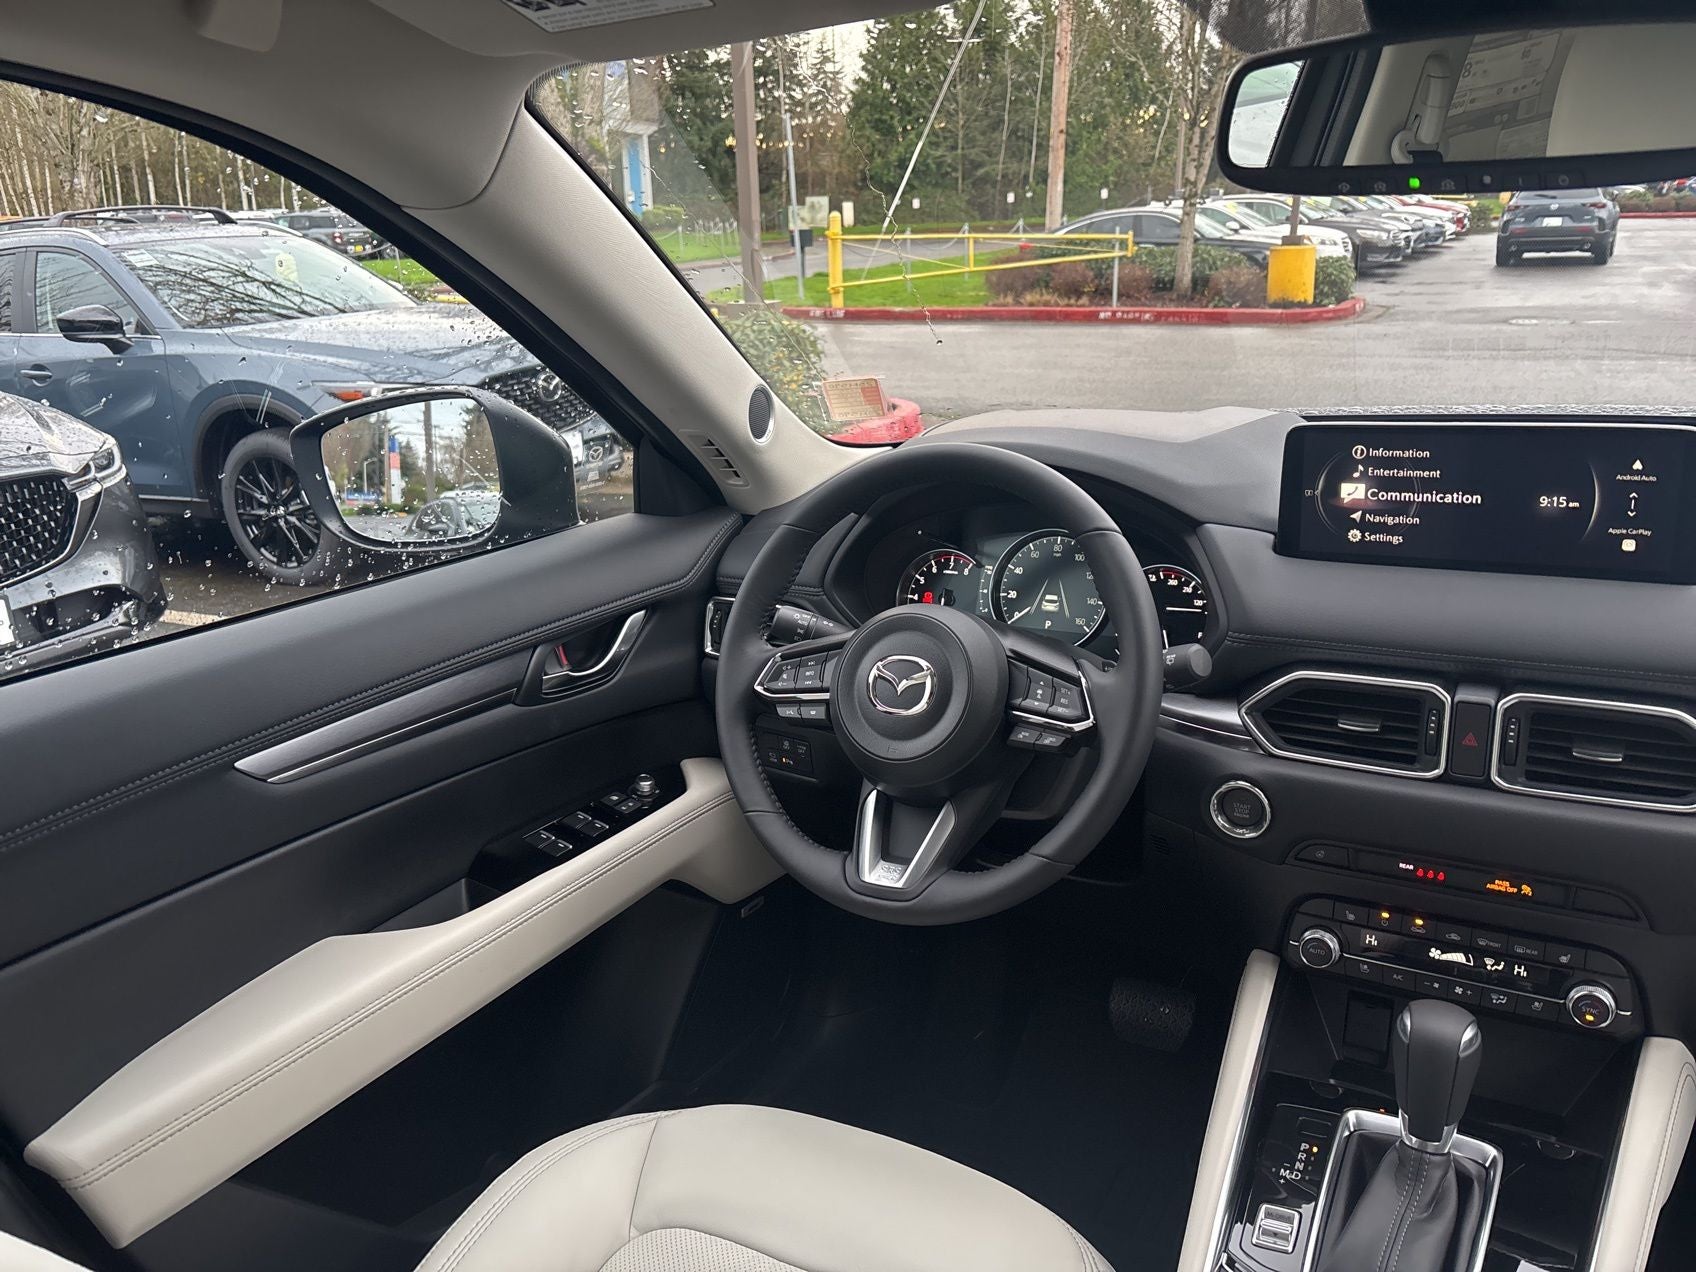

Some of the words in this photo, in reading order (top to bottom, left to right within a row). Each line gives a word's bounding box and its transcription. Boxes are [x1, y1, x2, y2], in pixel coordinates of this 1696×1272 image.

[1369, 447, 1430, 458] Information
[1368, 467, 1441, 478] Entertainment
[1367, 488, 1482, 504] Communication
[1539, 496, 1567, 508] 9:15
[1365, 513, 1420, 525] Navigation
[1608, 527, 1627, 535] Apple
[1628, 528, 1652, 537] CarPlay
[1364, 532, 1403, 545] Settings
[1053, 544, 1063, 552] 80
[1030, 551, 1039, 559] 60
[1074, 553, 1085, 561] 100
[931, 565, 937, 574] 6
[949, 562, 955, 570] 7
[1013, 566, 1023, 575] 40
[963, 568, 969, 576] 8
[919, 576, 925, 584] 5
[1007, 590, 1017, 599] 20
[1086, 597, 1098, 605] 140
[1044, 620, 1052, 629] P
[1075, 618, 1086, 626] 160
[1398, 862, 1414, 871] REAR
[1485, 882, 1506, 892] AIRBAG
[1494, 879, 1510, 887] PASS
[1308, 947, 1326, 956] AUTO
[1581, 1005, 1600, 1015] SYNC
[1299, 1142, 1310, 1151] P
[1297, 1152, 1307, 1161] R
[1294, 1160, 1305, 1171] N
[1279, 1168, 1290, 1177] M
[1292, 1171, 1302, 1180] D
